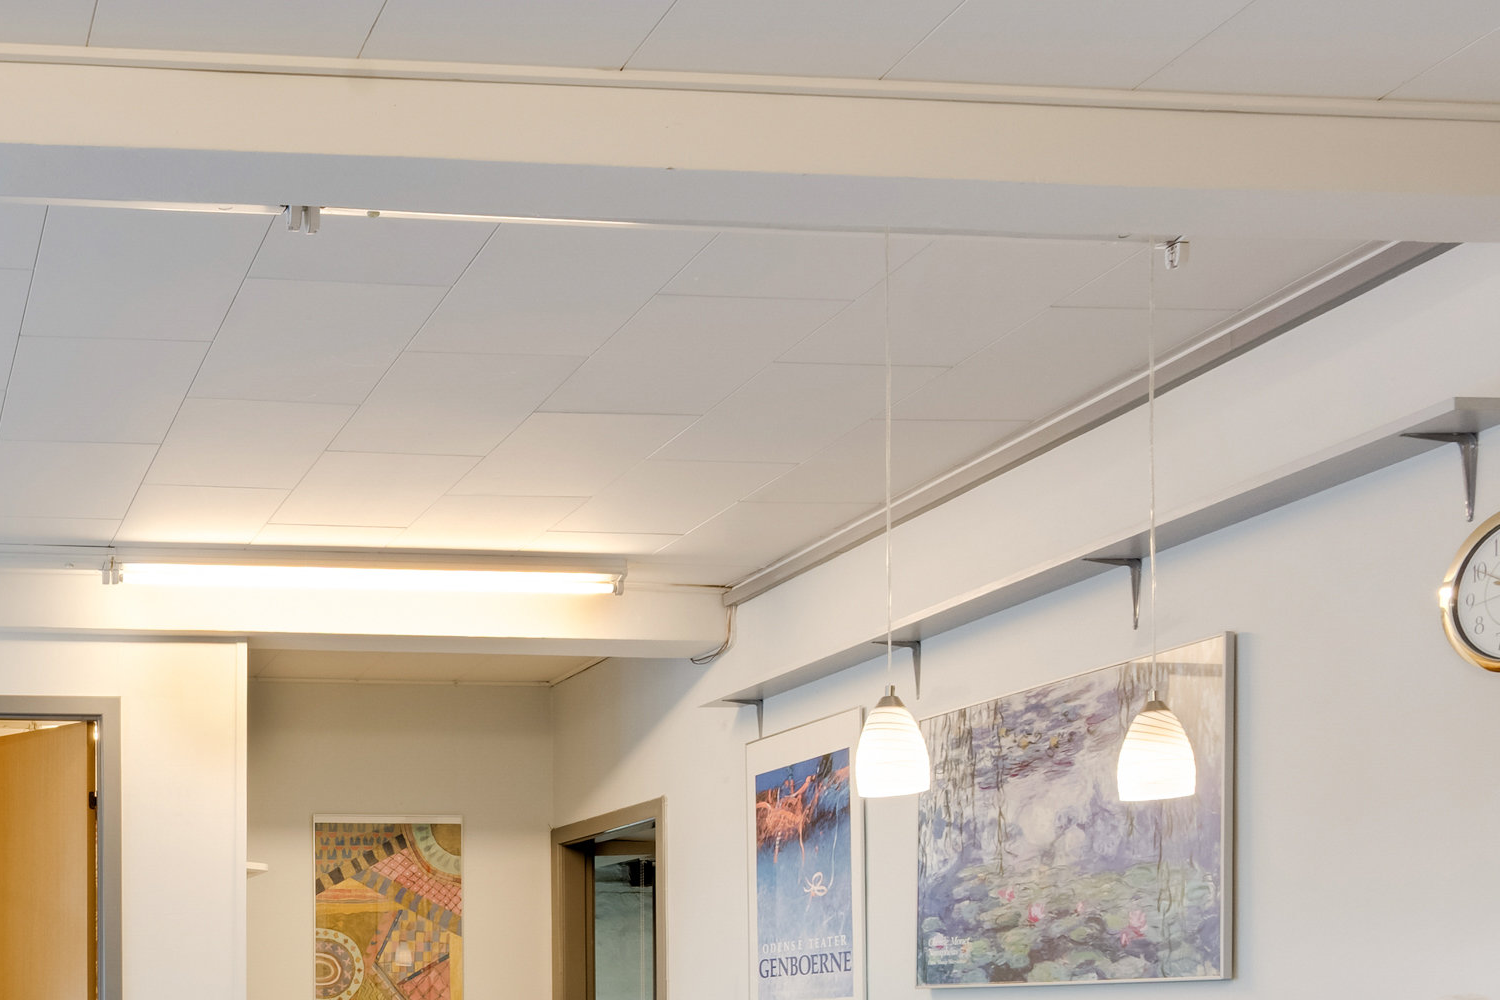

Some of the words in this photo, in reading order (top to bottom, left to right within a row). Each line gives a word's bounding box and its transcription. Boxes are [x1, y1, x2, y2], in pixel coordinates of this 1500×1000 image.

[1473, 562, 1488, 583] 10
[1465, 592, 1476, 612] 9
[1474, 615, 1485, 635] 8
[762, 938, 802, 954] ODENSE
[809, 935, 848, 949] TEATER
[759, 951, 852, 979] GENBOERNE
